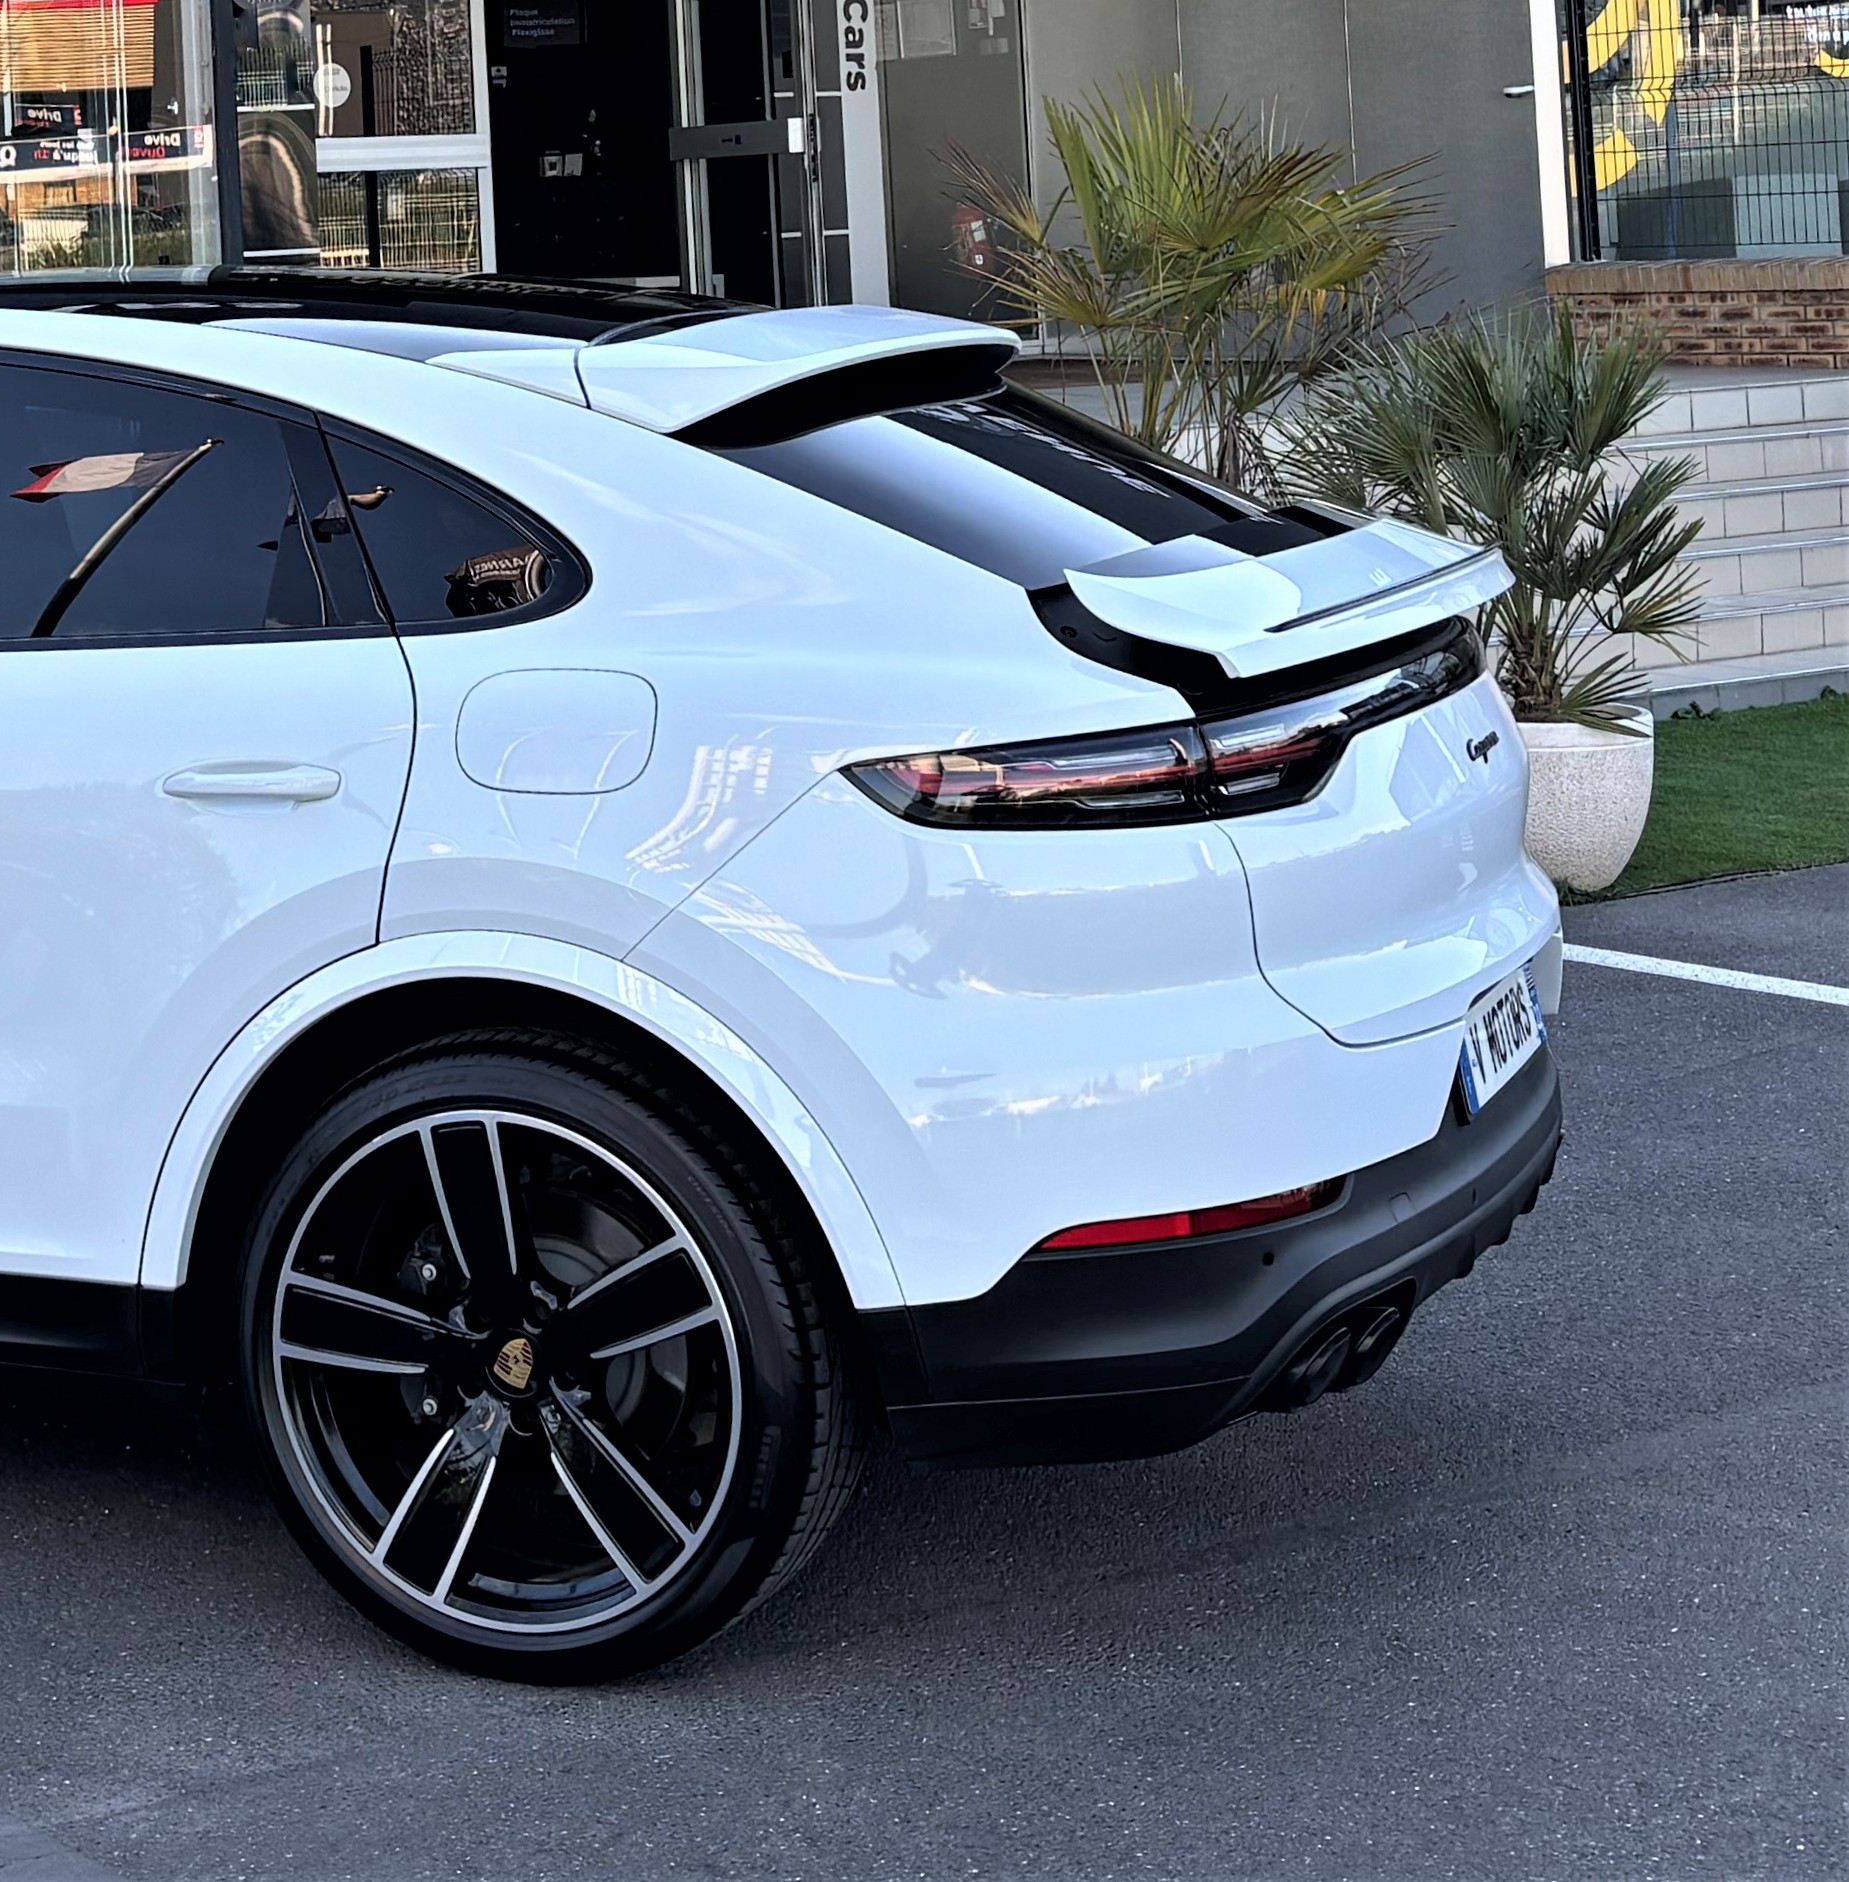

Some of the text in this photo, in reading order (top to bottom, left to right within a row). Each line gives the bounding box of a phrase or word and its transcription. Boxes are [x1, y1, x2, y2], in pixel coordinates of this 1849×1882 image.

[843, 0, 867, 91] Cars
[1469, 981, 1531, 1085] V MOTORS
